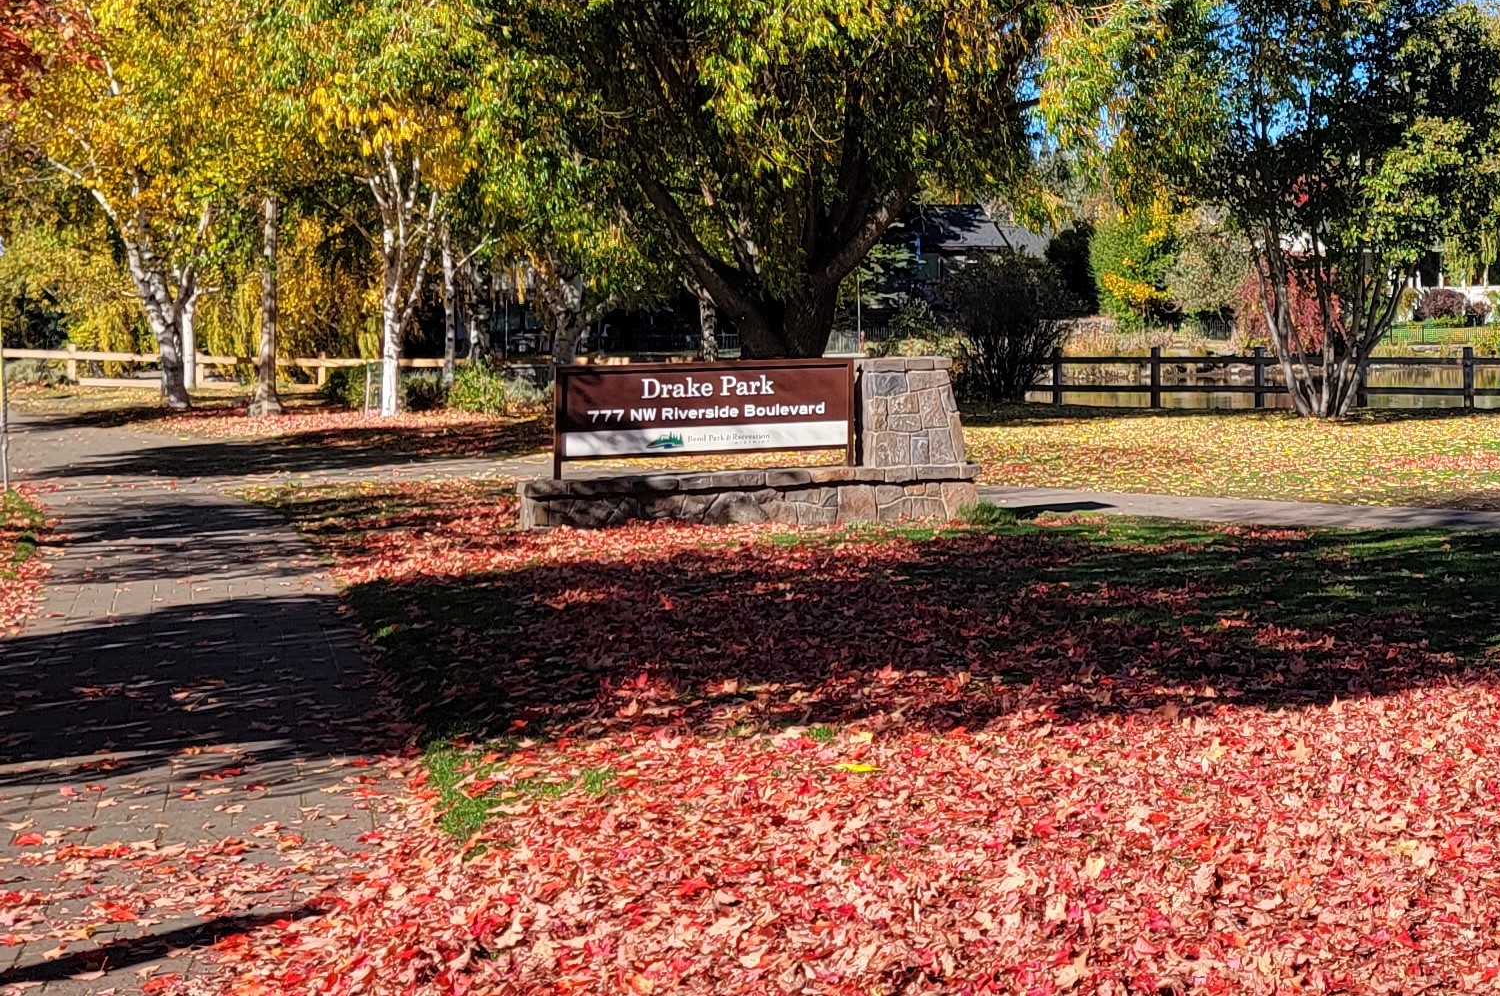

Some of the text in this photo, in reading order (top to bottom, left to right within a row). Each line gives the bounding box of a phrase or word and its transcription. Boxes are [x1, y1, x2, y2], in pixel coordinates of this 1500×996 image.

[641, 375, 775, 399] Drake Park
[587, 402, 825, 423] 777 NW Riverside Boulevard
